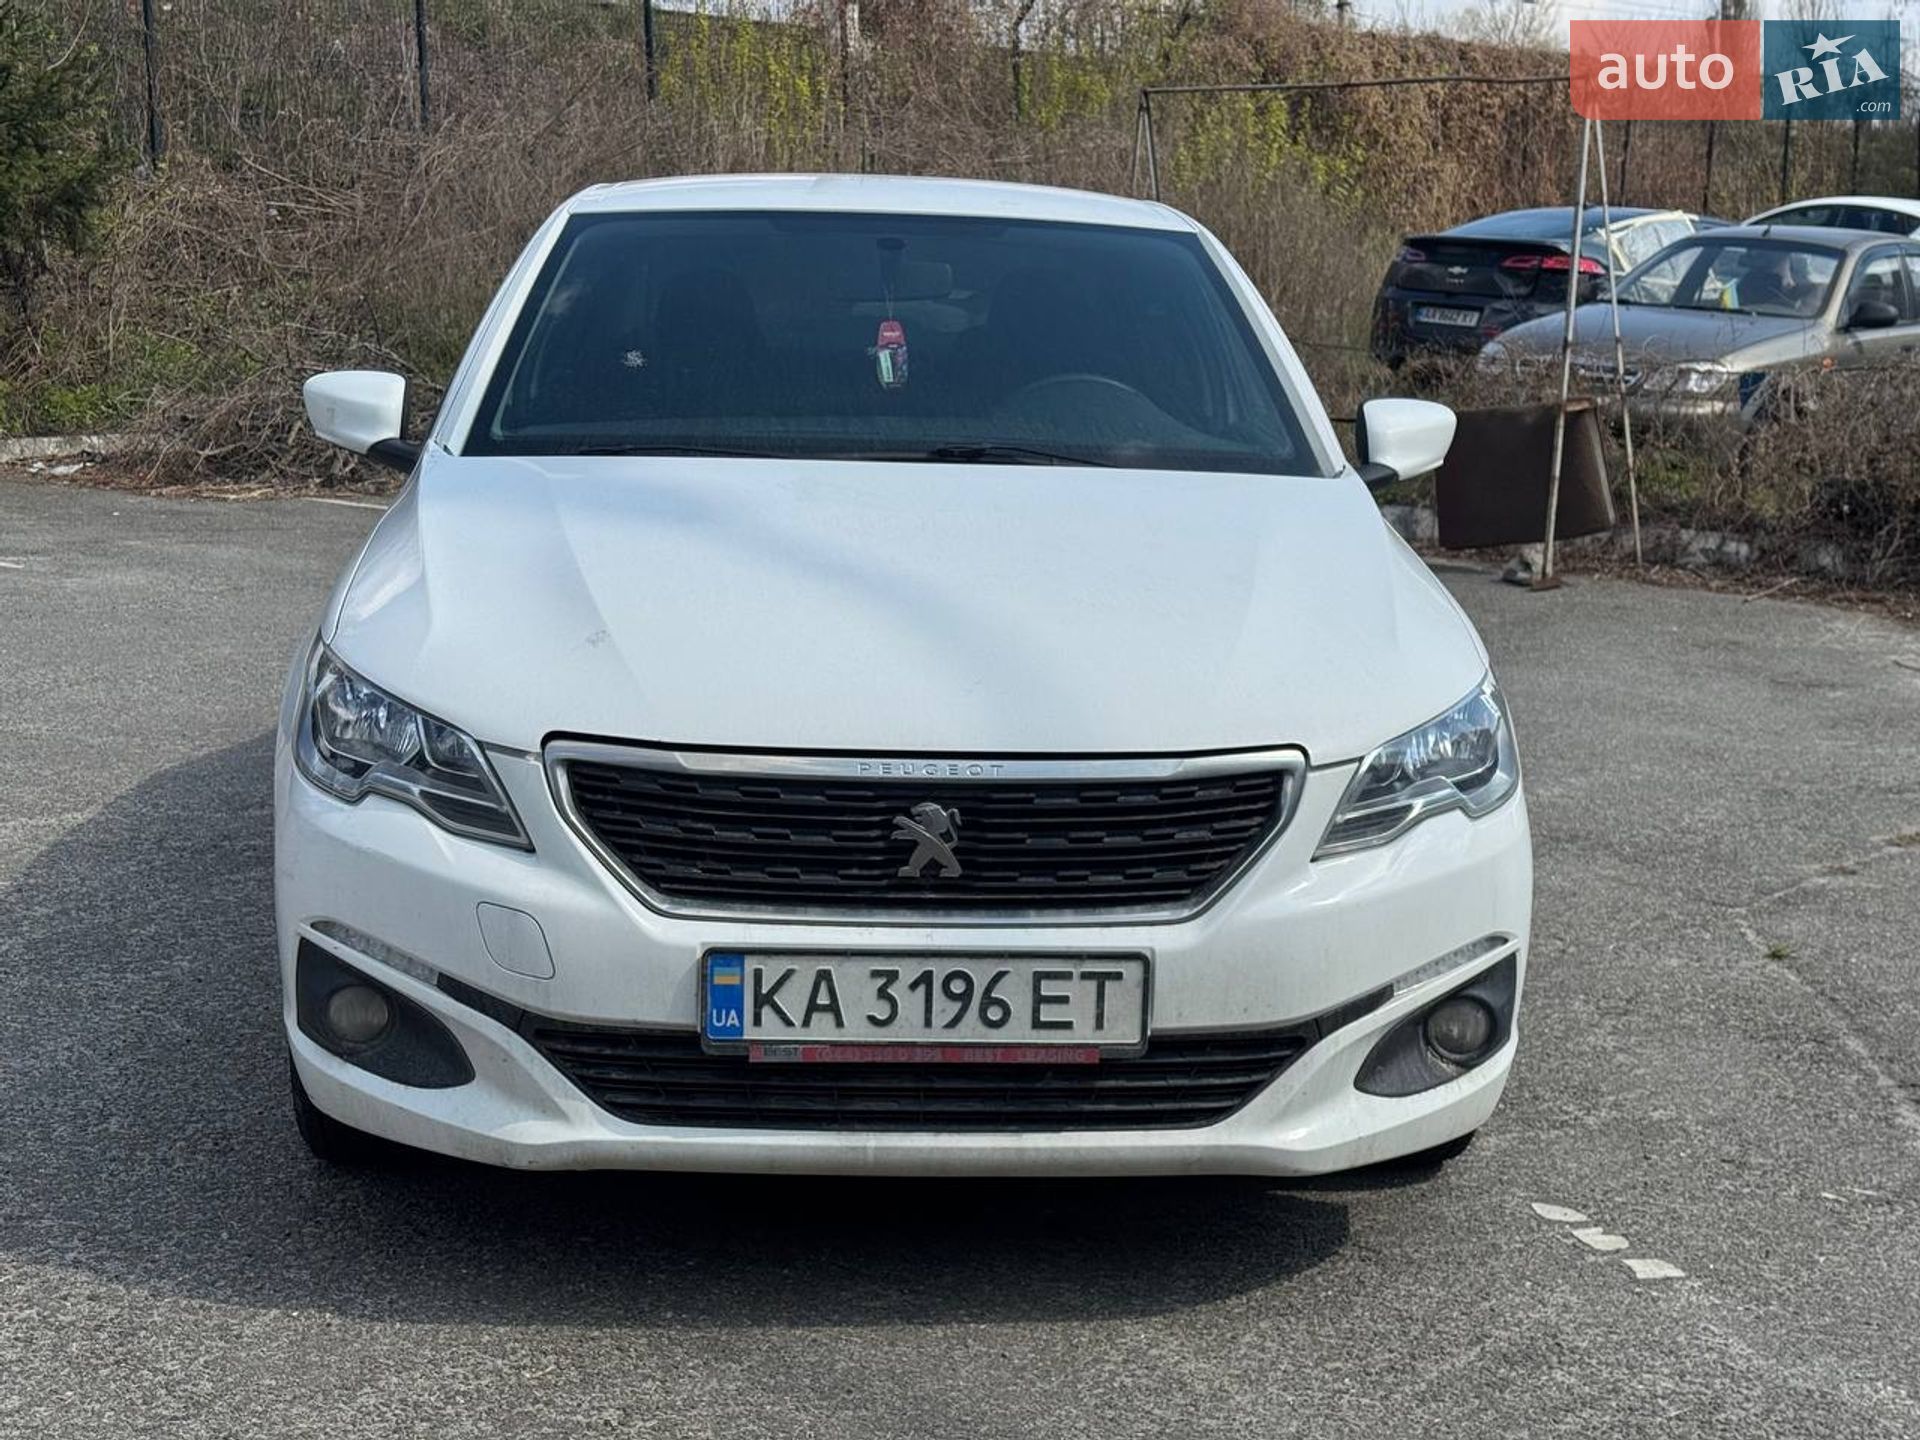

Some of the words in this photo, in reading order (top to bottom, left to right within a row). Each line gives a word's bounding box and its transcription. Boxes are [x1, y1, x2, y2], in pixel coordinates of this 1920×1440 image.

[857, 762, 1005, 777] PEUGEOT
[752, 967, 845, 1029] KA
[866, 968, 1013, 1030] 3196
[1031, 970, 1125, 1031] ET
[712, 1008, 740, 1028] UA
